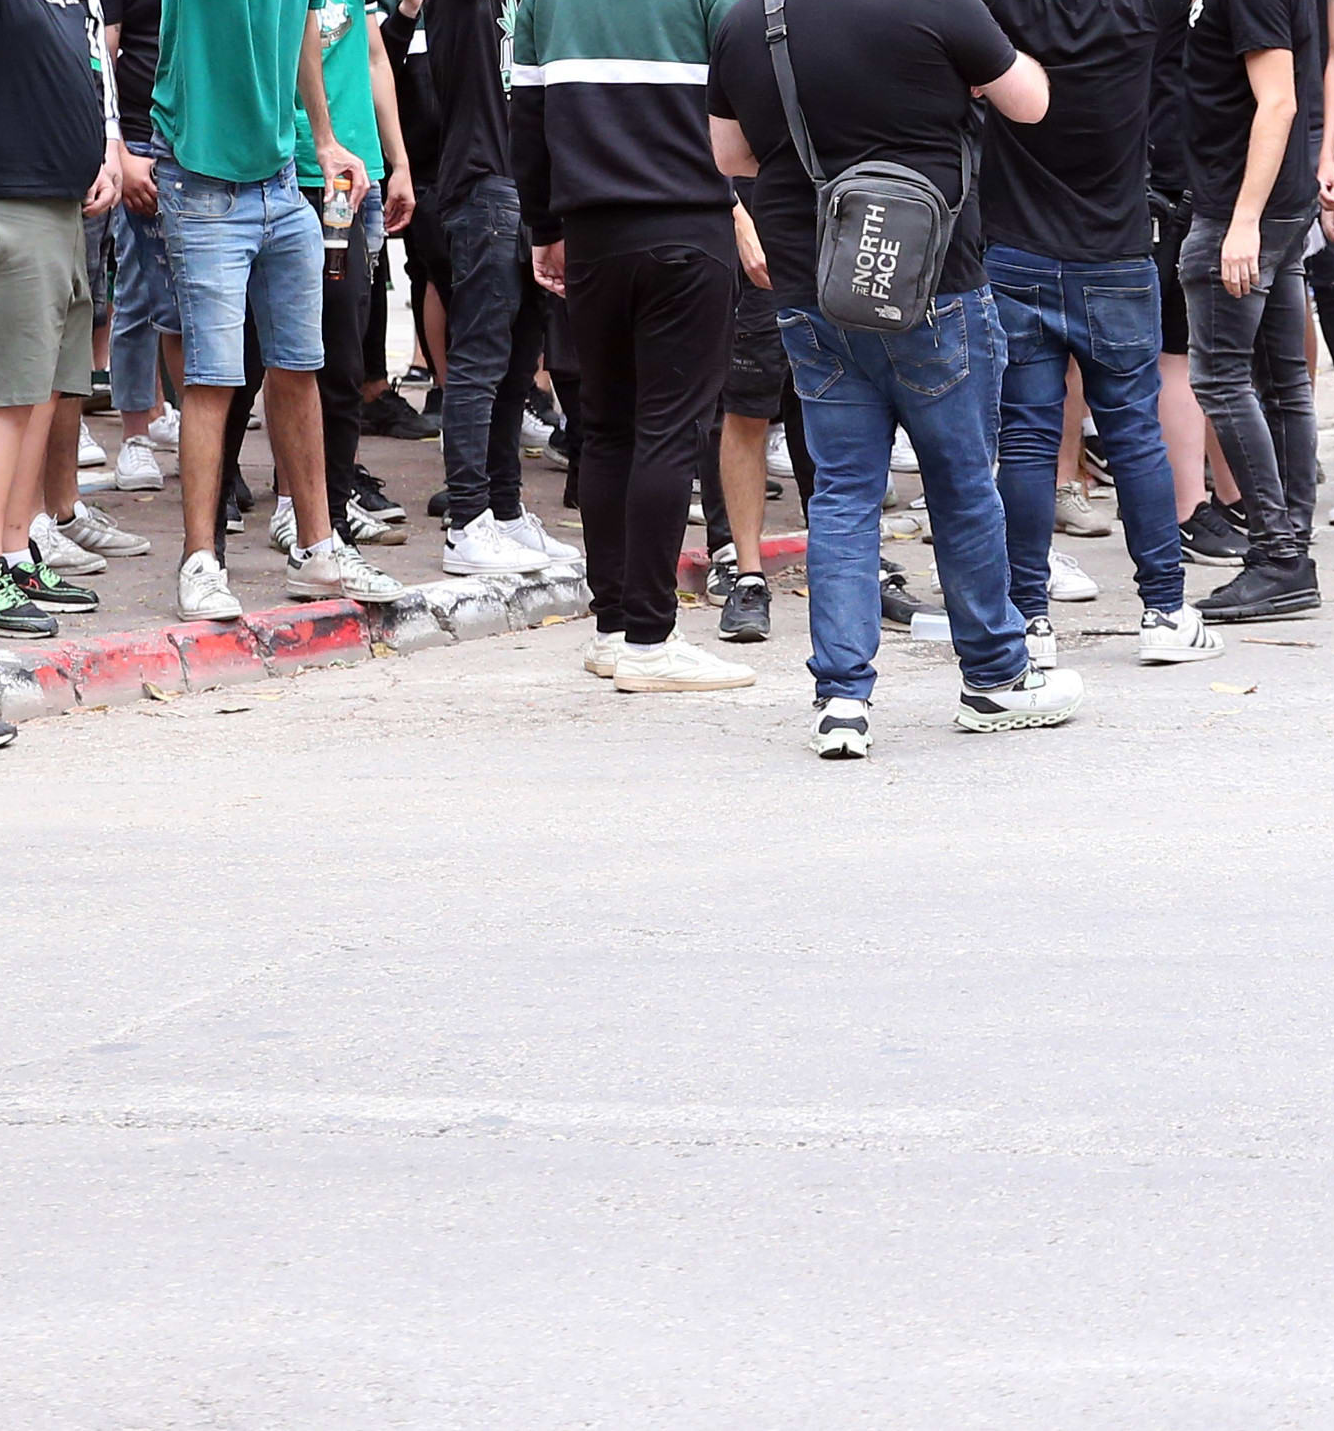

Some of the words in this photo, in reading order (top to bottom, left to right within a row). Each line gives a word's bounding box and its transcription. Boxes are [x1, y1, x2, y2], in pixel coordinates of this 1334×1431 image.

[851, 203, 887, 288] NORTH
[870, 238, 901, 301] FACE
[851, 283, 870, 297] THE
